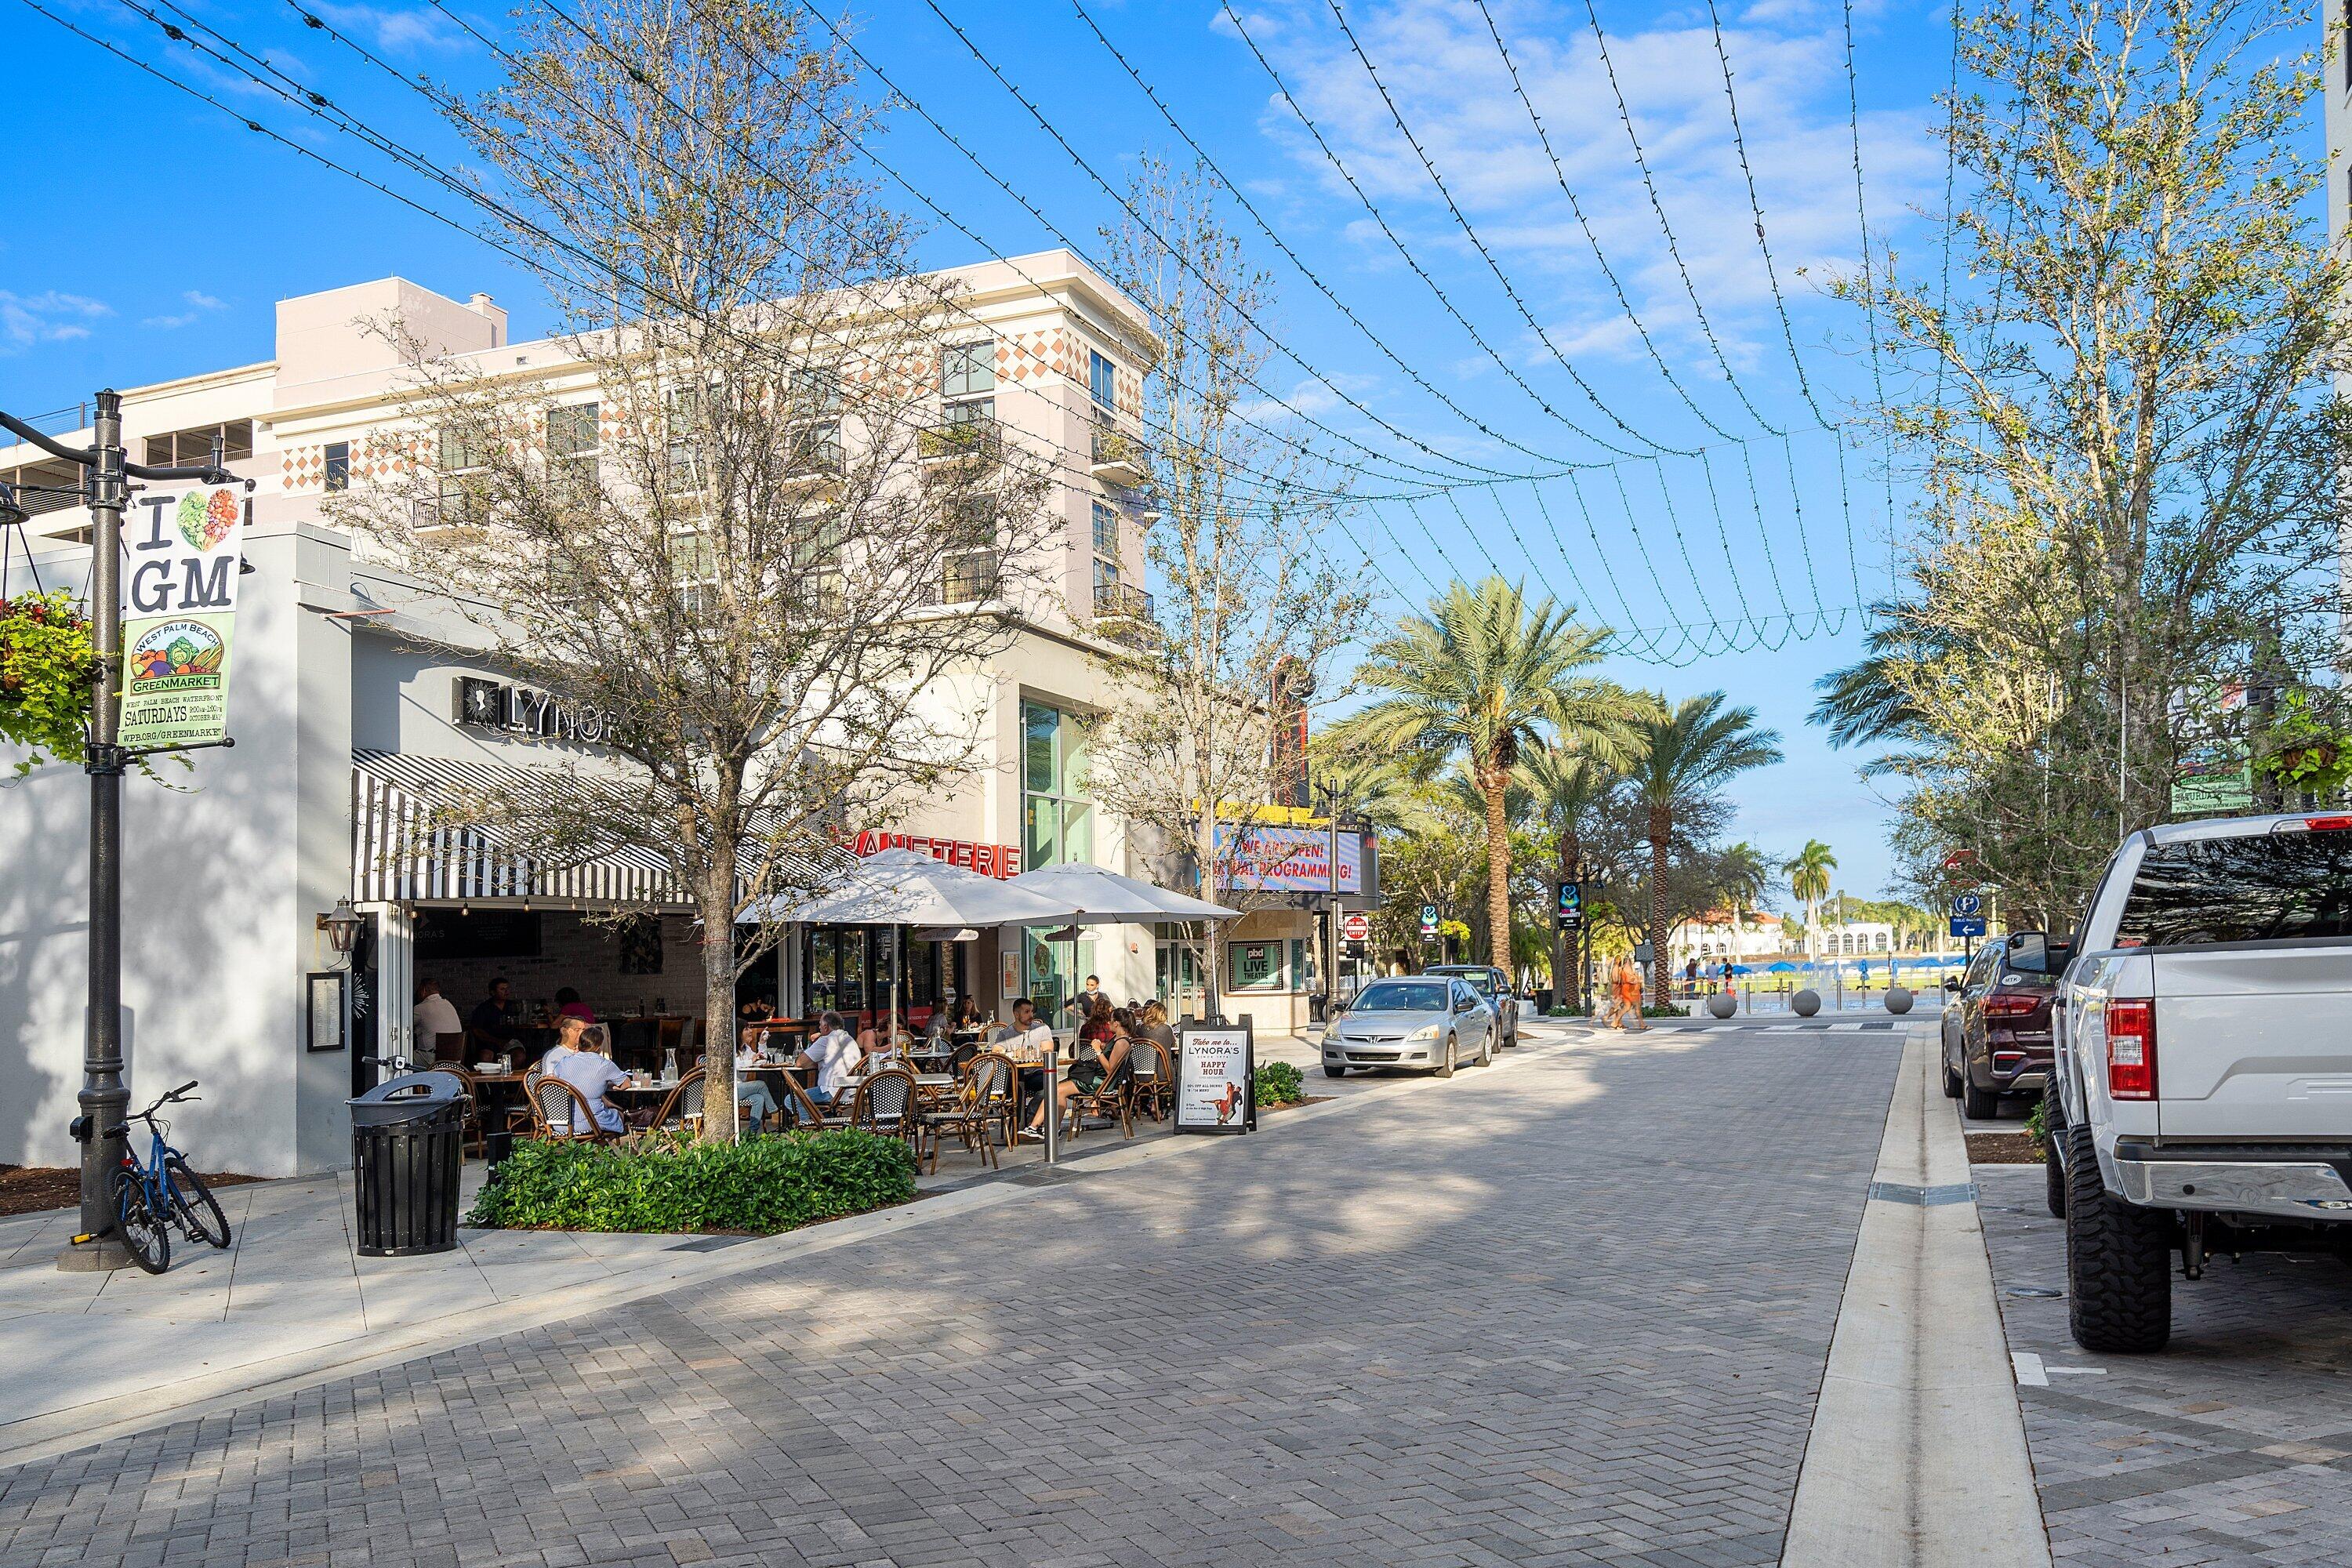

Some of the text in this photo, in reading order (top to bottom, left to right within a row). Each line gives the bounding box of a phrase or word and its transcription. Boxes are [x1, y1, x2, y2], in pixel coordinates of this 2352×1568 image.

[136, 495, 176, 550] I
[132, 556, 234, 613] GM
[136, 623, 219, 652] WEST PALM BEACH
[132, 677, 219, 692] GREENMARKET
[125, 706, 187, 728] SATURDAYS
[123, 728, 222, 742] WPB.ORG/GREENMARKET
[1291, 844, 1323, 858] PEN!
[1247, 948, 1264, 959] pbd
[1243, 960, 1268, 972] LIVE
